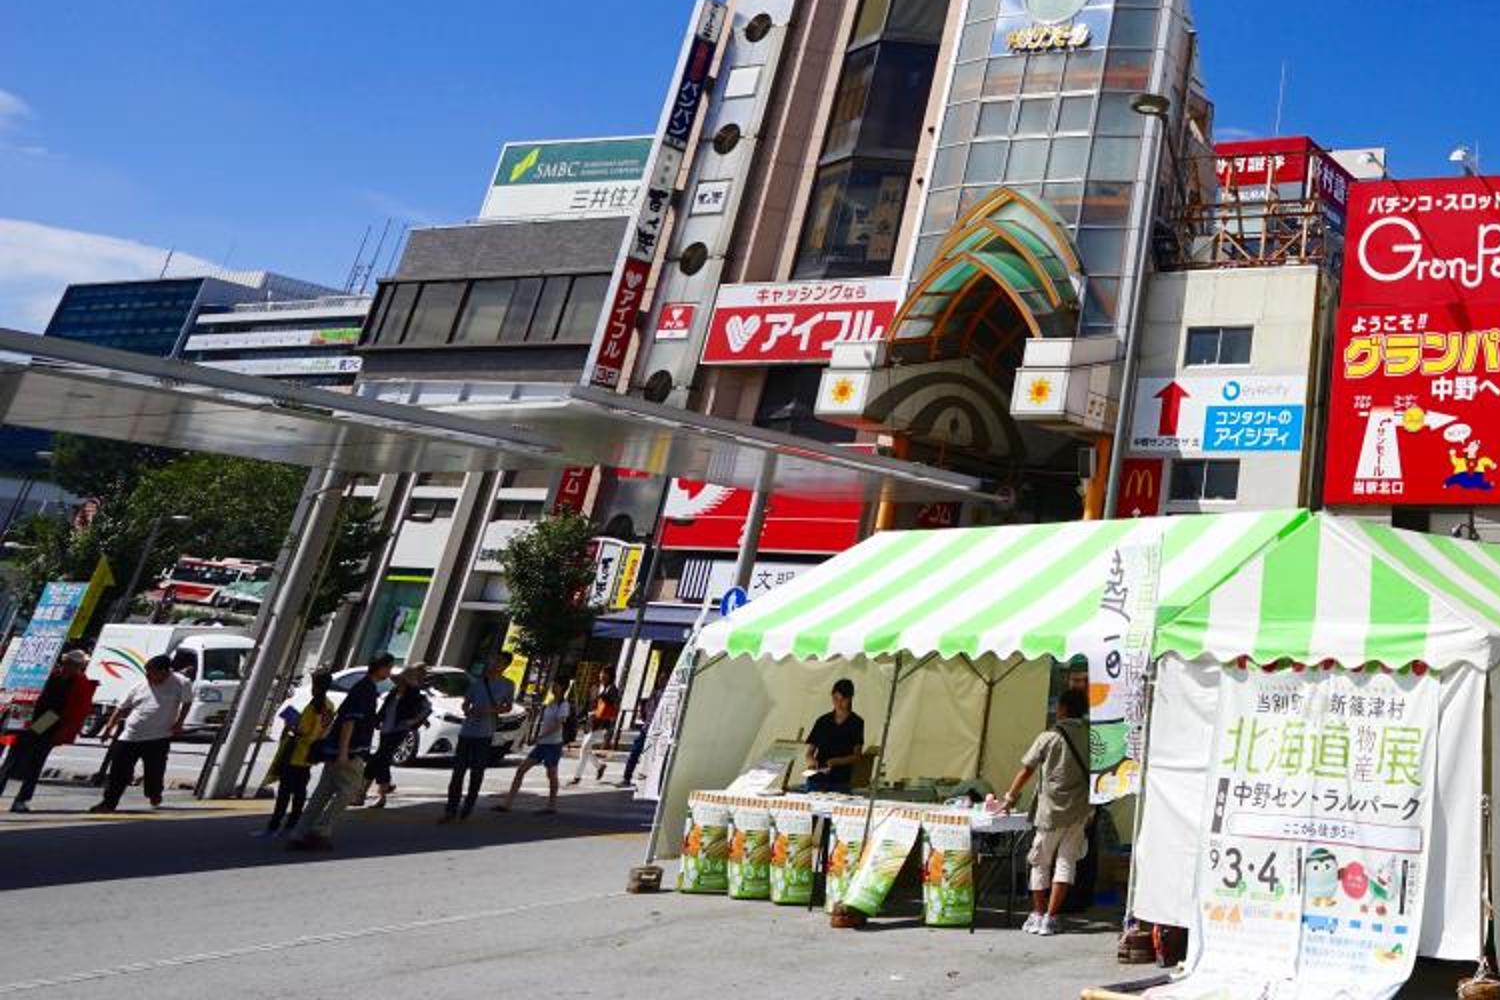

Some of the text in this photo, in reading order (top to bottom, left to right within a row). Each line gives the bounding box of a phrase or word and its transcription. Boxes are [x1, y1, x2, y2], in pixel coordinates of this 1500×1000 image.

[534, 159, 581, 179] SMBC
[756, 285, 867, 302] キャッシングなら
[760, 309, 886, 352] アイフル
[1215, 408, 1293, 427] コンタクトの
[1213, 428, 1291, 447] アイシティ
[1329, 693, 1407, 720] 新篠津村
[1220, 716, 1423, 787] 北海道 物産 展
